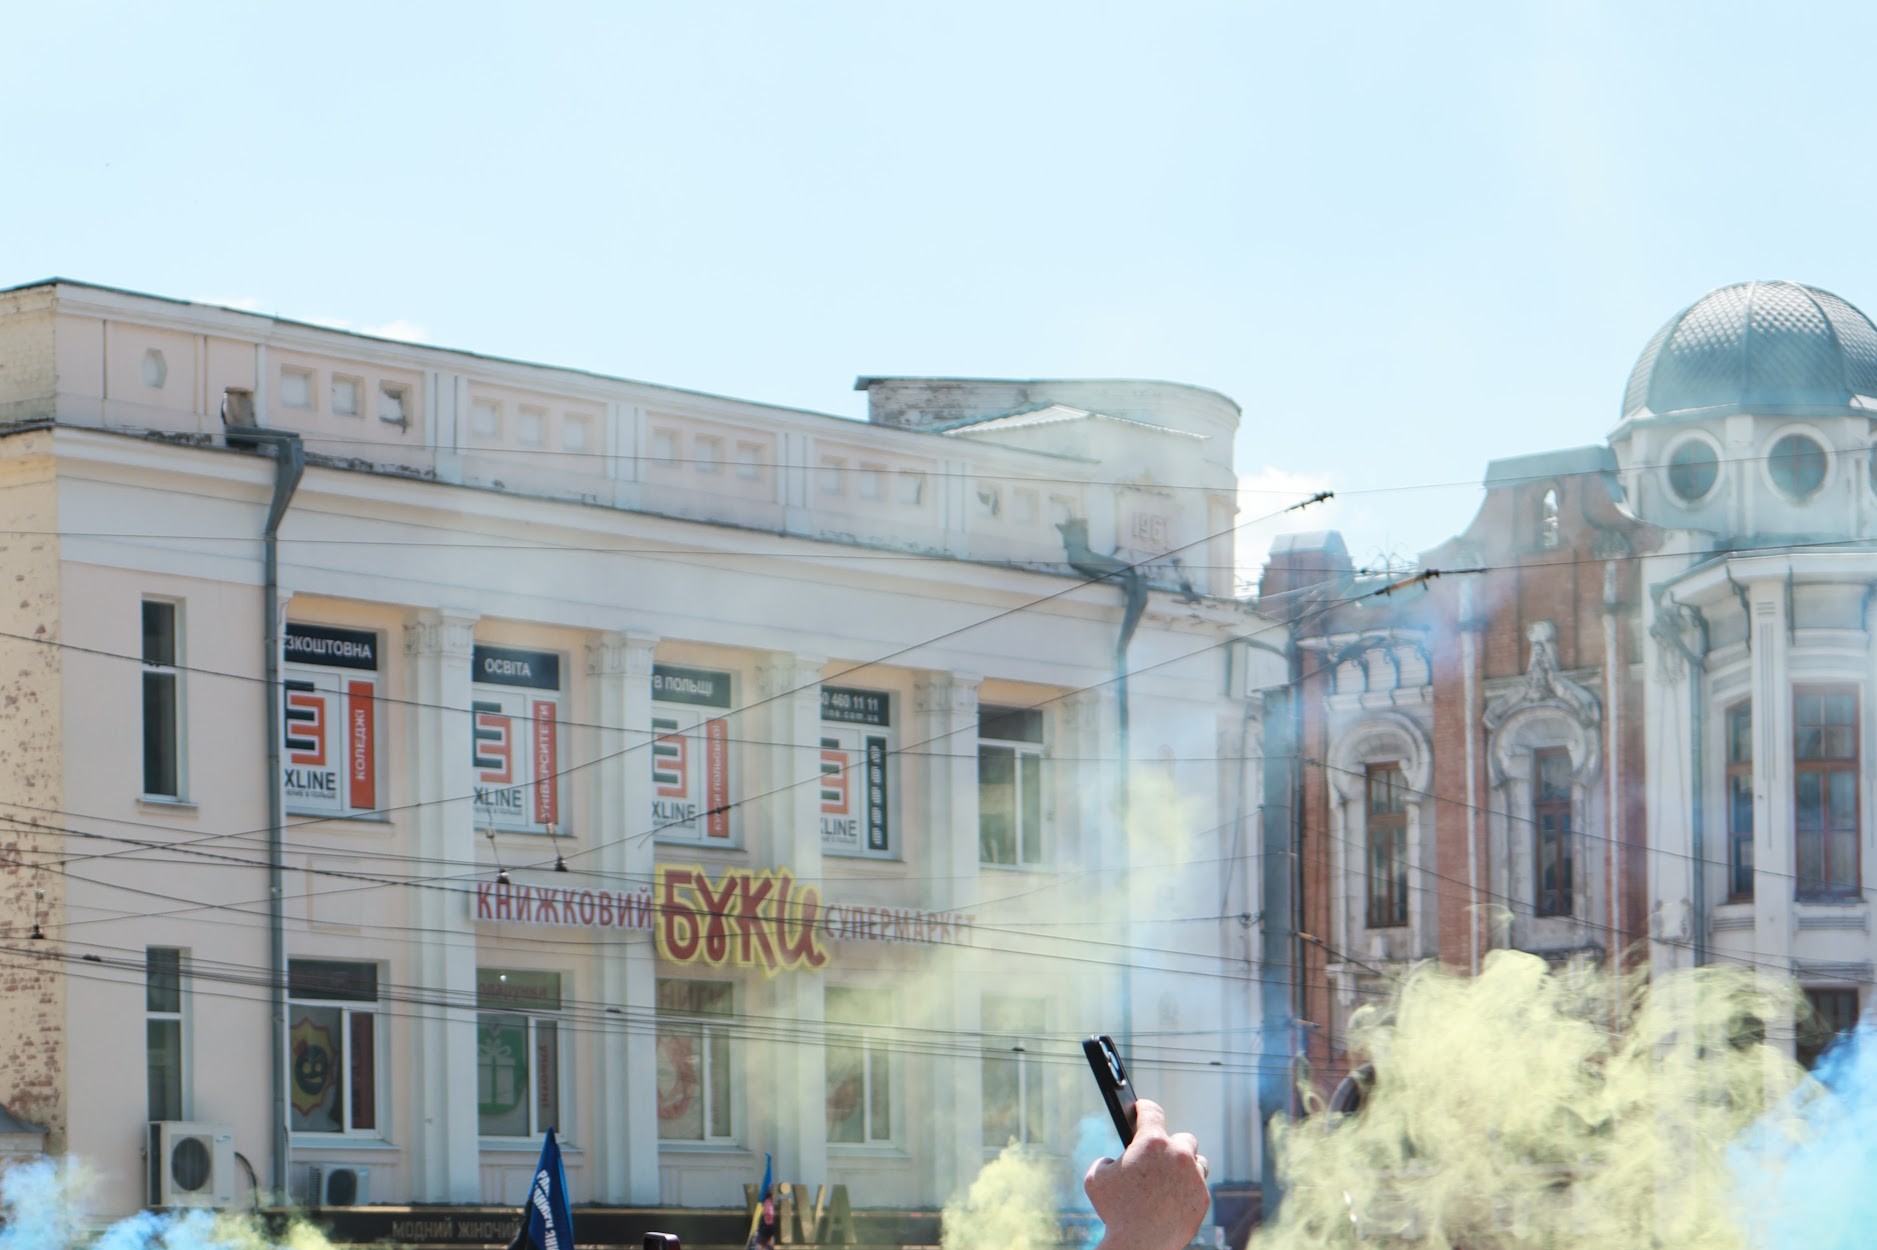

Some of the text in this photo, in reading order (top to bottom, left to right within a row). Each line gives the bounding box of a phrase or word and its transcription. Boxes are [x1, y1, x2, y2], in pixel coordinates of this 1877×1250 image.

[484, 658, 532, 678] ОСВІТА
[477, 881, 651, 930] КНИЖКОВИЙ
[391, 1215, 452, 1242] МОДНИЙ
